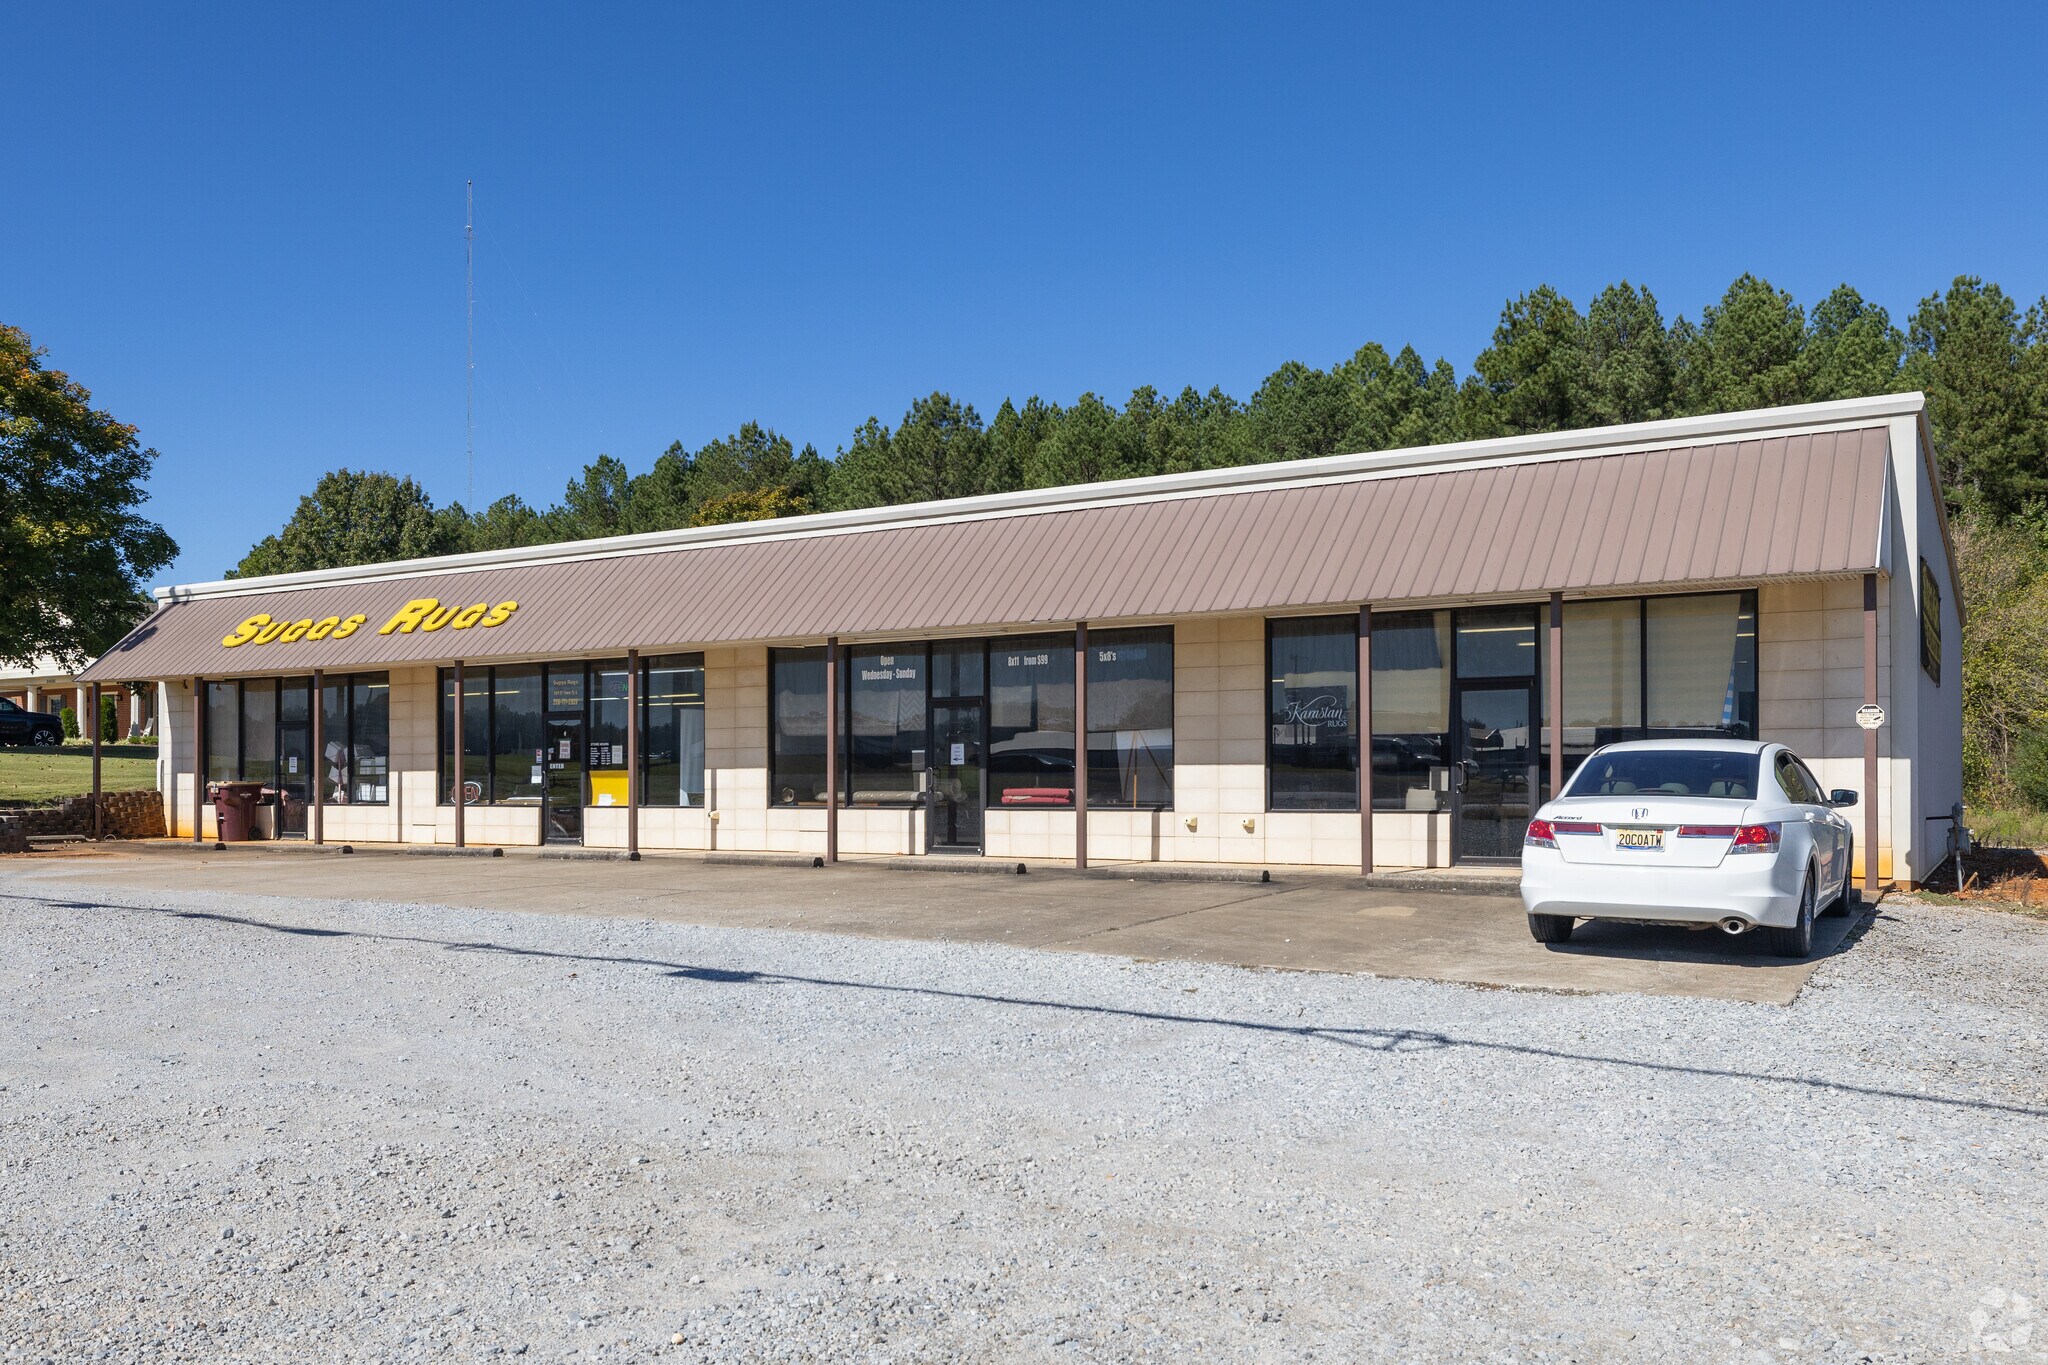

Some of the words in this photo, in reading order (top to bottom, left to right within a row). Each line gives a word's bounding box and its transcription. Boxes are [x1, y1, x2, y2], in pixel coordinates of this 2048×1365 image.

[880, 655, 894, 666] Open
[1008, 656, 1019, 666] 8x11
[1024, 655, 1036, 666] from
[1037, 654, 1048, 665] $99
[1099, 651, 1117, 662] 5x8's
[861, 669, 892, 681] Wednesday
[896, 668, 916, 679] Sunday
[1284, 695, 1344, 726] Karastan
[1327, 719, 1347, 727] RUGS
